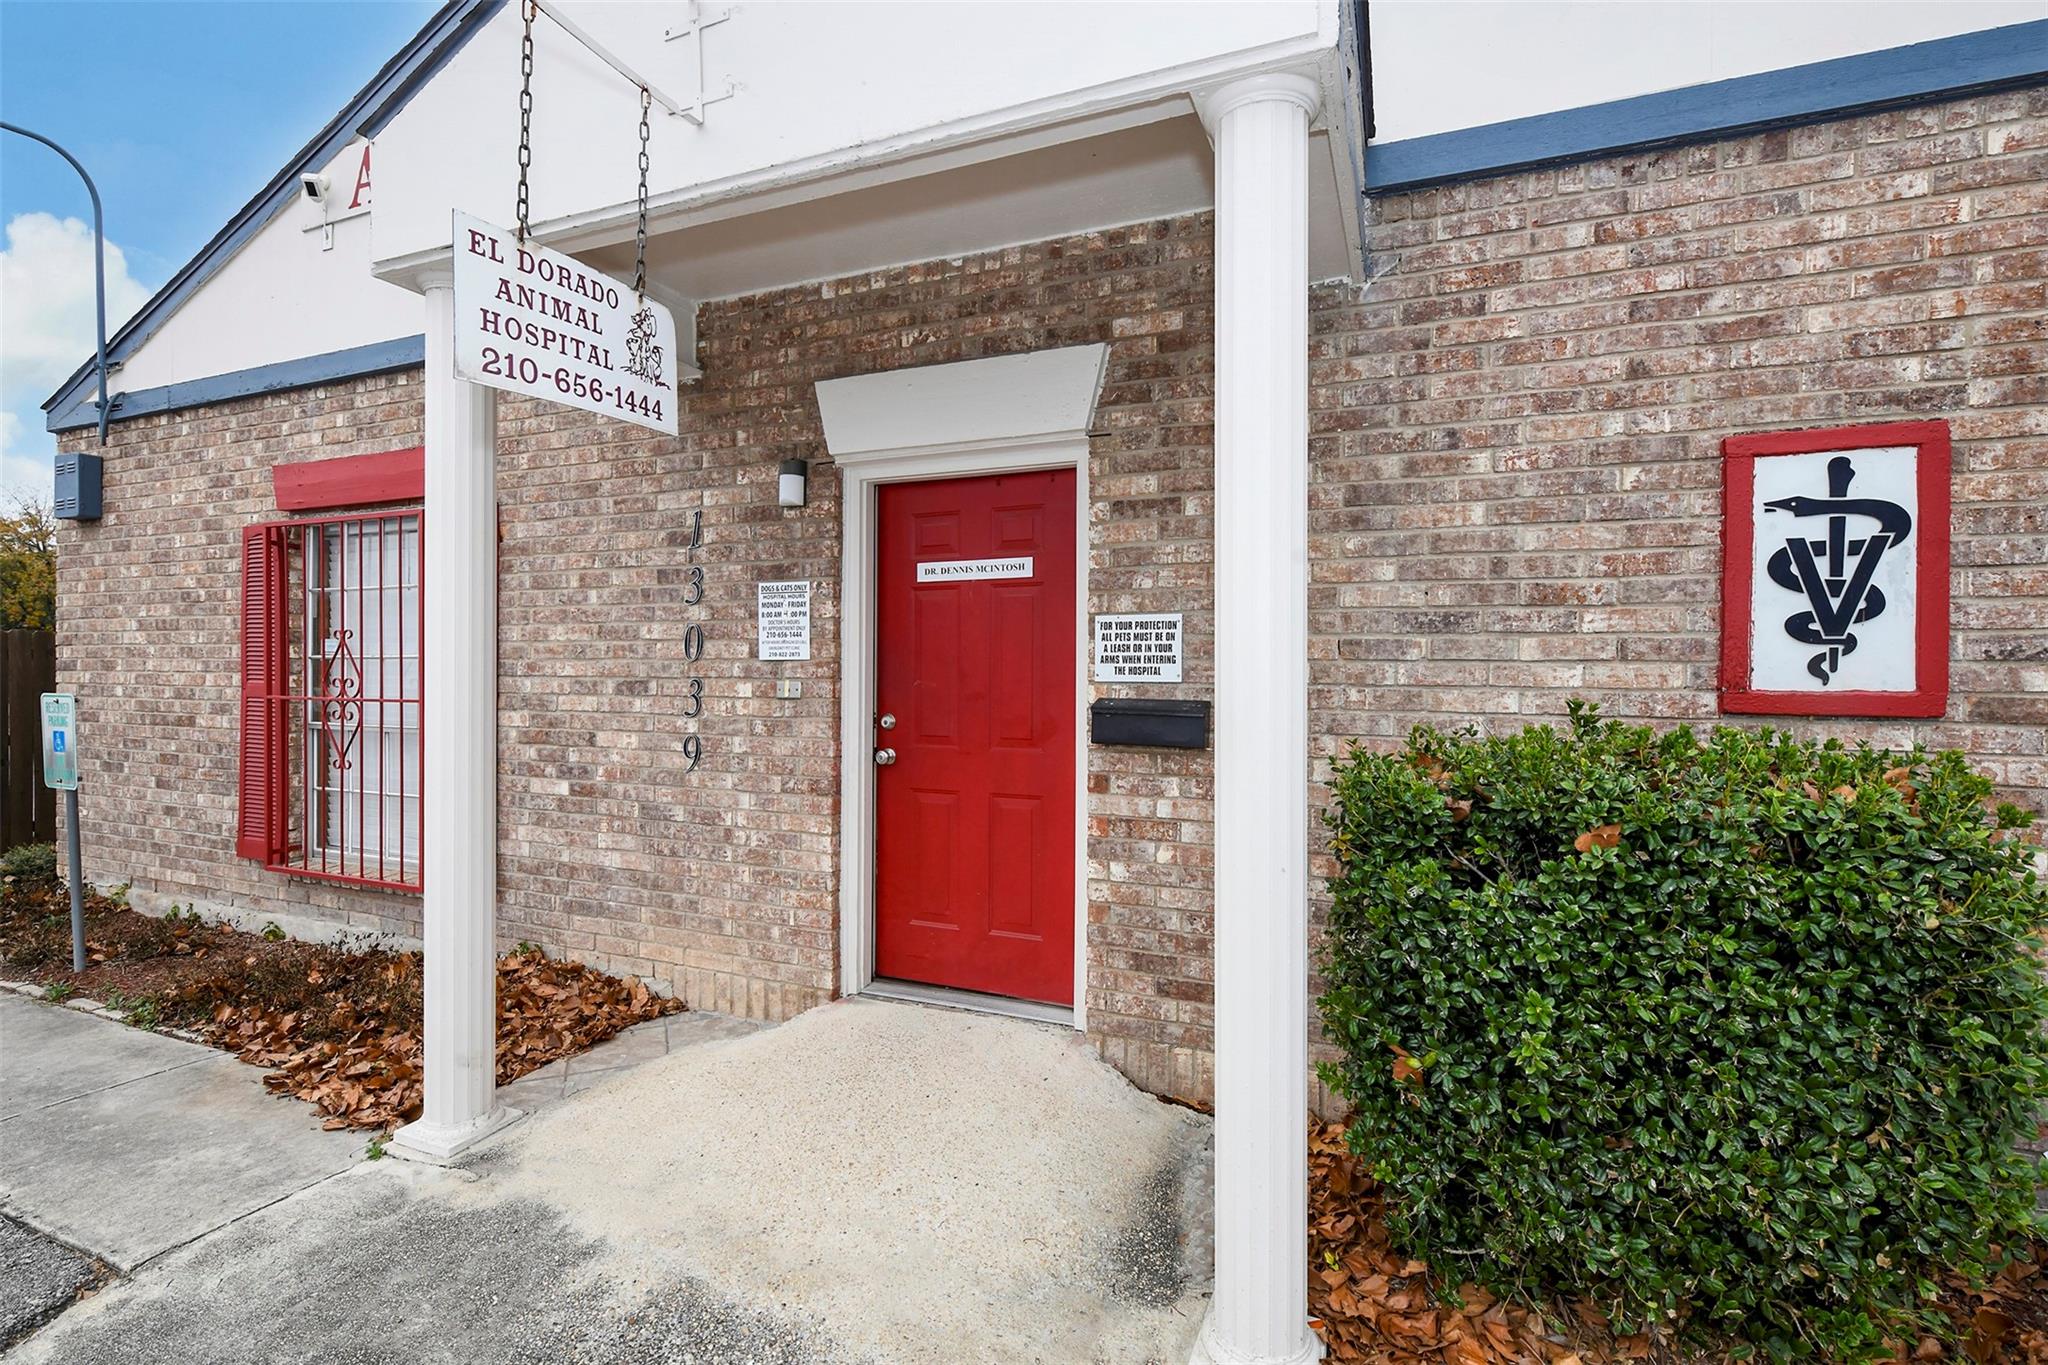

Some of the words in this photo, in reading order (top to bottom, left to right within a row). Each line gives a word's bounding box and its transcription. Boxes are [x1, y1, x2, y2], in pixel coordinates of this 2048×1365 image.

[468, 229, 504, 264] EL
[516, 248, 619, 310] DORADO
[495, 277, 603, 335] ANIMAL
[479, 307, 614, 371] HOSPITAL
[481, 346, 664, 422] 210-656-1444
[924, 567, 938, 576] DR.
[940, 565, 974, 575] DENNIS
[975, 562, 1025, 574] MCINTOSH
[1100, 621, 1113, 630] FOR
[1114, 621, 1133, 630] YOUR
[1134, 620, 1177, 630] PROTECTION
[1101, 633, 1112, 642] ALL
[1114, 632, 1131, 642] PETS
[1133, 632, 1152, 641] MUST
[1154, 632, 1163, 641] BE
[1166, 632, 1176, 641] ON
[1103, 644, 1108, 653] A
[1110, 644, 1131, 653] LEASH
[1132, 644, 1142, 652] OR
[1144, 644, 1152, 652] IN
[1154, 644, 1173, 652] YOUR
[1100, 655, 1120, 664] ARMS
[1121, 655, 1141, 664] WHEN
[1143, 655, 1176, 664] ENTERING
[1114, 666, 1126, 675] THE
[1128, 666, 1161, 675] HOSPITAL
